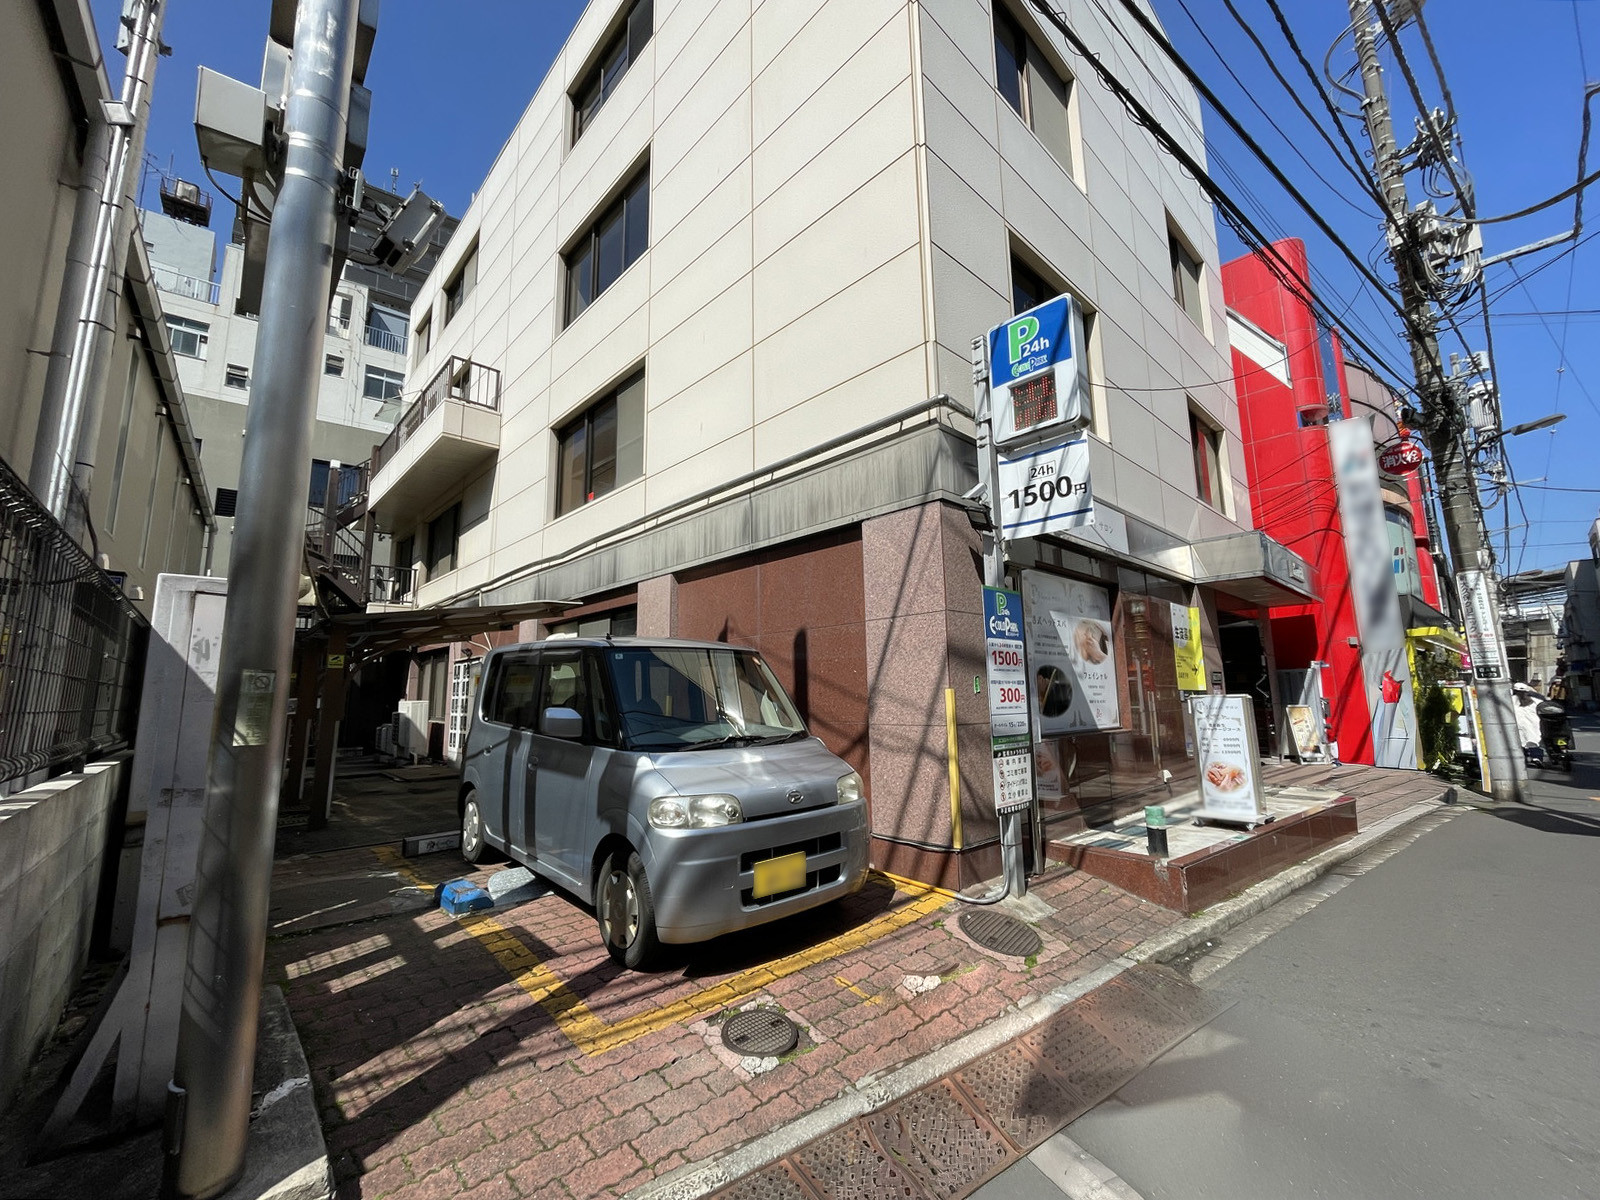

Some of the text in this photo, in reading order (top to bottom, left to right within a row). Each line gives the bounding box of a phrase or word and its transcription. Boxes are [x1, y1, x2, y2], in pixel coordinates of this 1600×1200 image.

[1008, 316, 1040, 364] P
[1022, 336, 1050, 357] 24h
[1382, 450, 1420, 468] 消火栓
[1030, 464, 1054, 478] 24h
[1008, 476, 1088, 509] 1500円
[991, 650, 1023, 668] 1500円
[999, 687, 1026, 703] 300円
